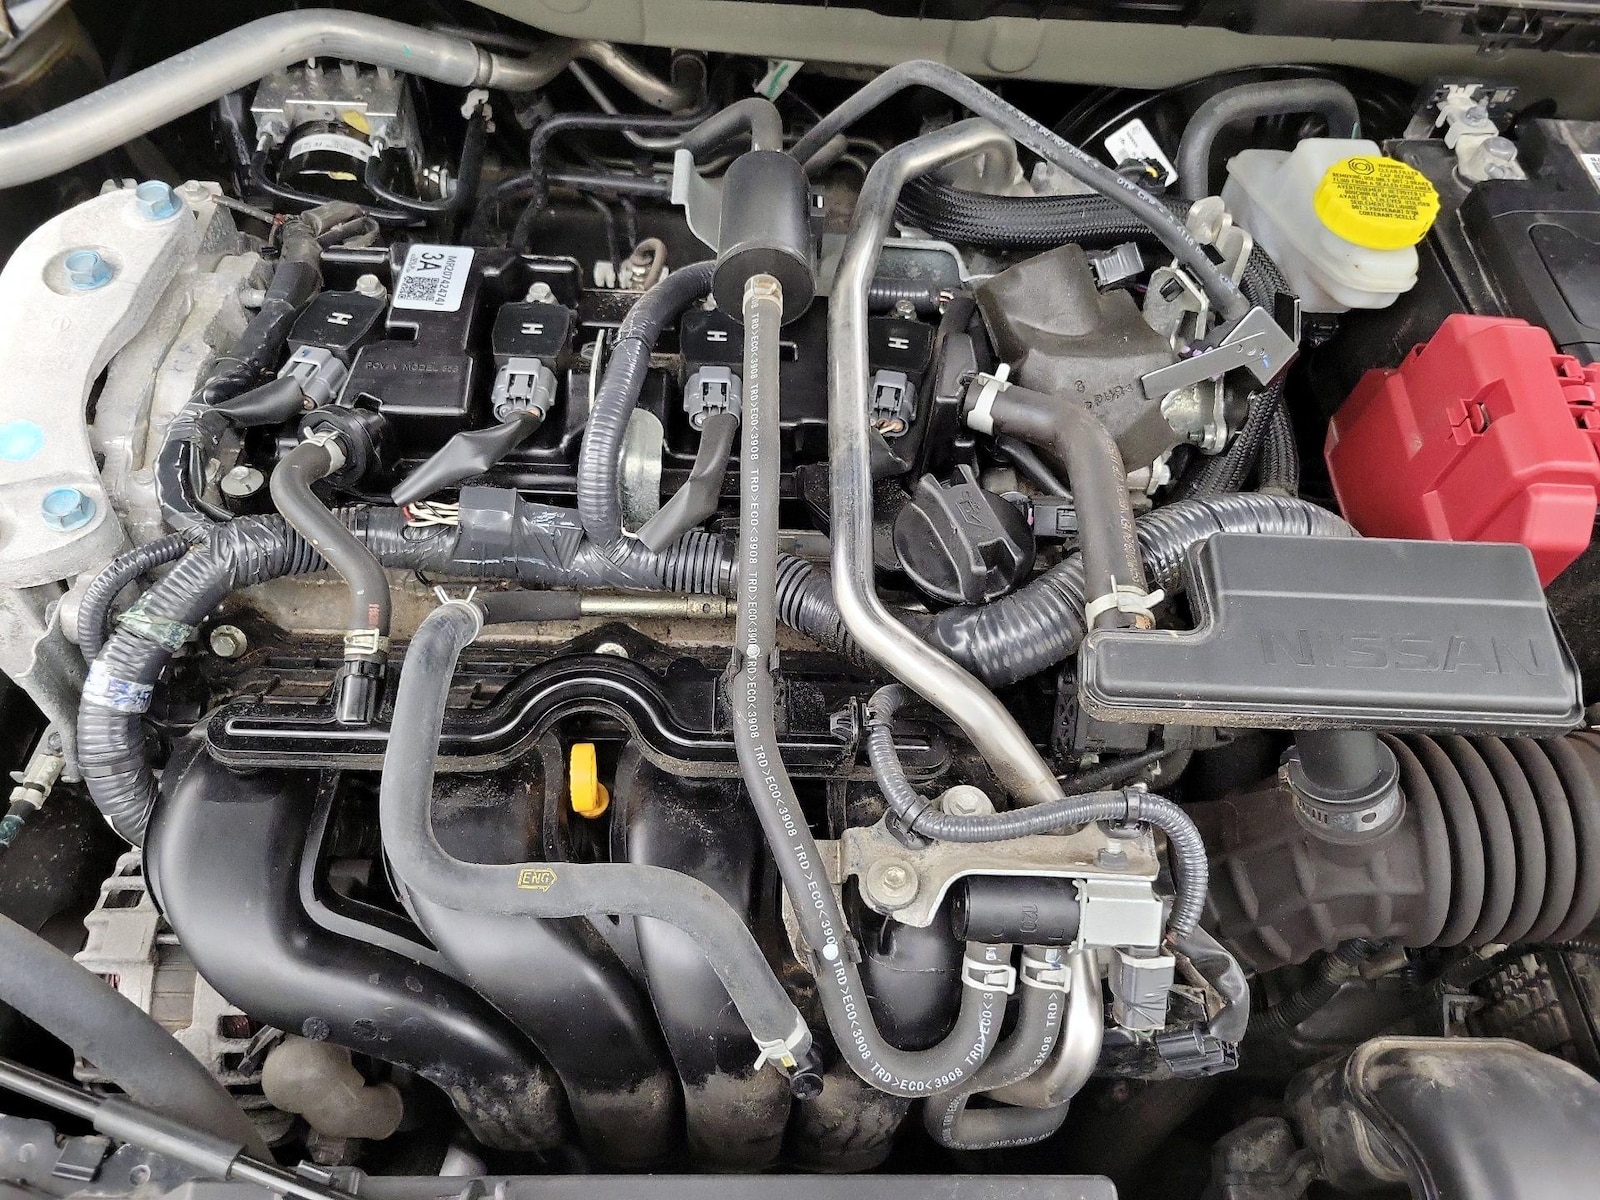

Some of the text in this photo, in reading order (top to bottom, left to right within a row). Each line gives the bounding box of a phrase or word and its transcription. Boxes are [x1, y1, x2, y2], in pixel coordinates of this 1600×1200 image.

[417, 252, 445, 271] 3A
[1253, 628, 1550, 677] NISSAN
[522, 871, 550, 884] ENG
